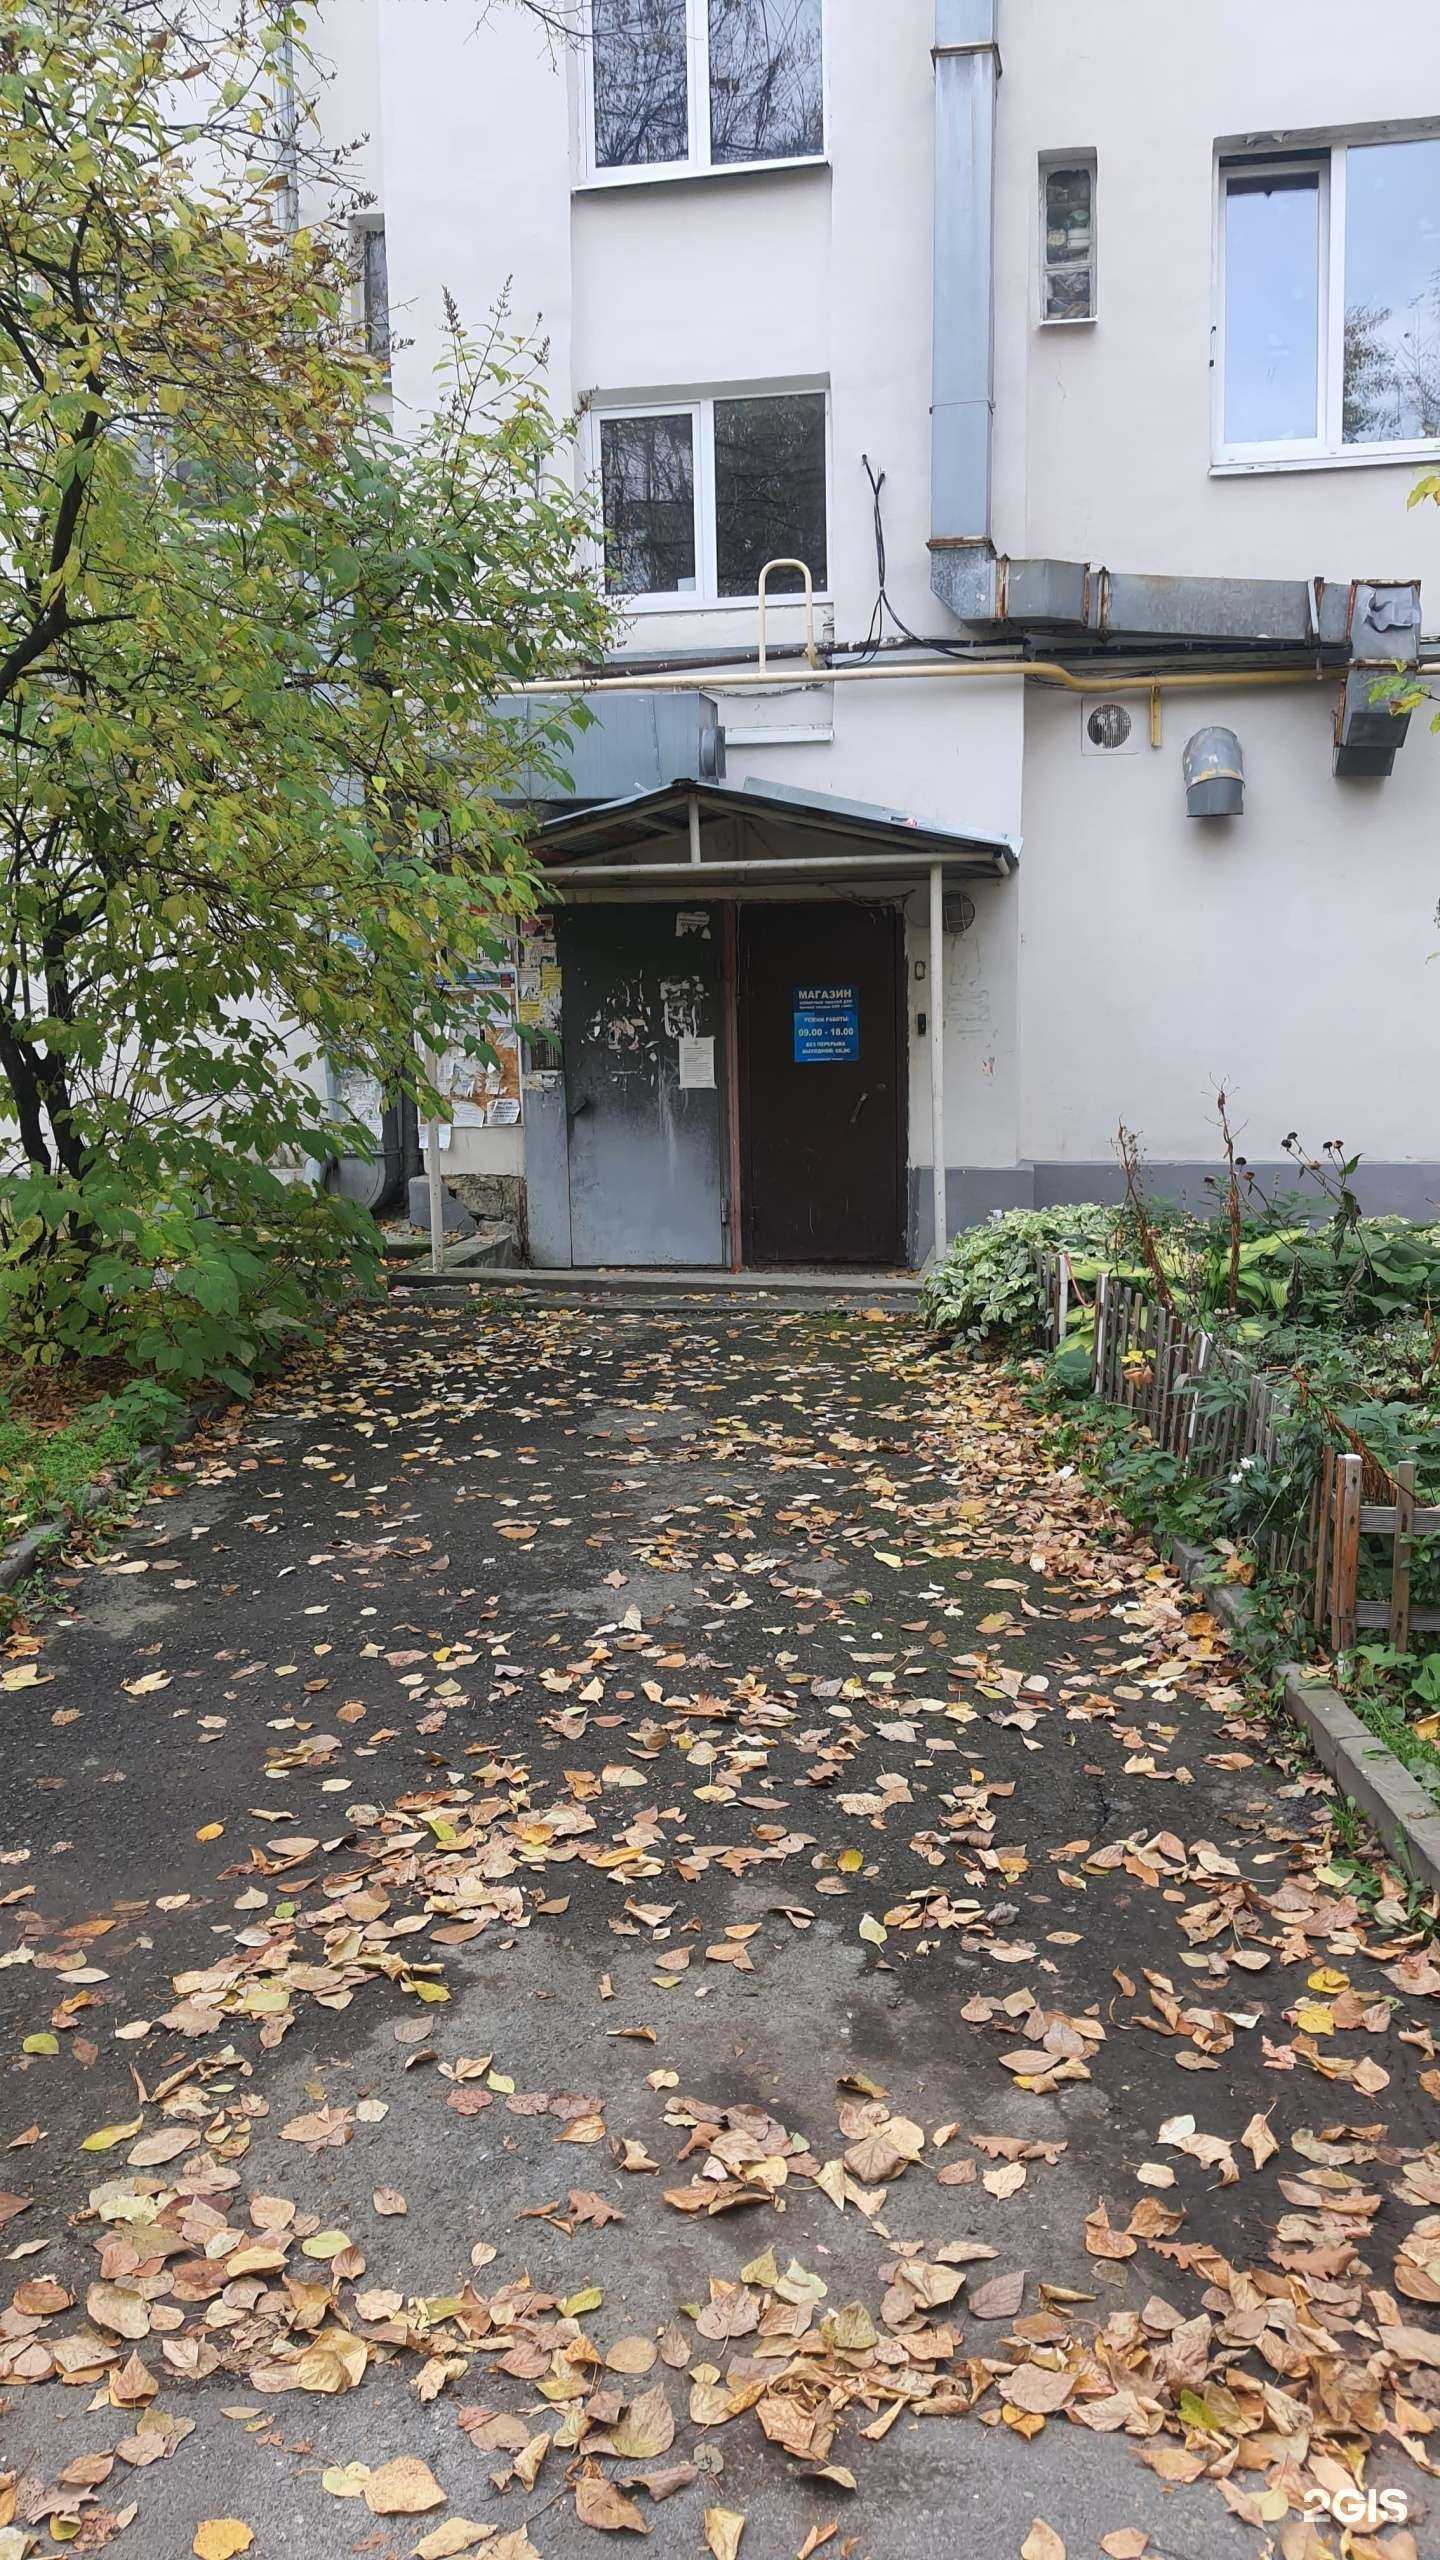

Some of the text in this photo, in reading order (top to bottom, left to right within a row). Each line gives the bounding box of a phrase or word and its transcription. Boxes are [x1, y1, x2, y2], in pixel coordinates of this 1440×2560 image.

[798, 989, 852, 999] МАГАЗИН
[798, 1028, 822, 1036] 09.00
[830, 1027, 853, 1036] 18.00
